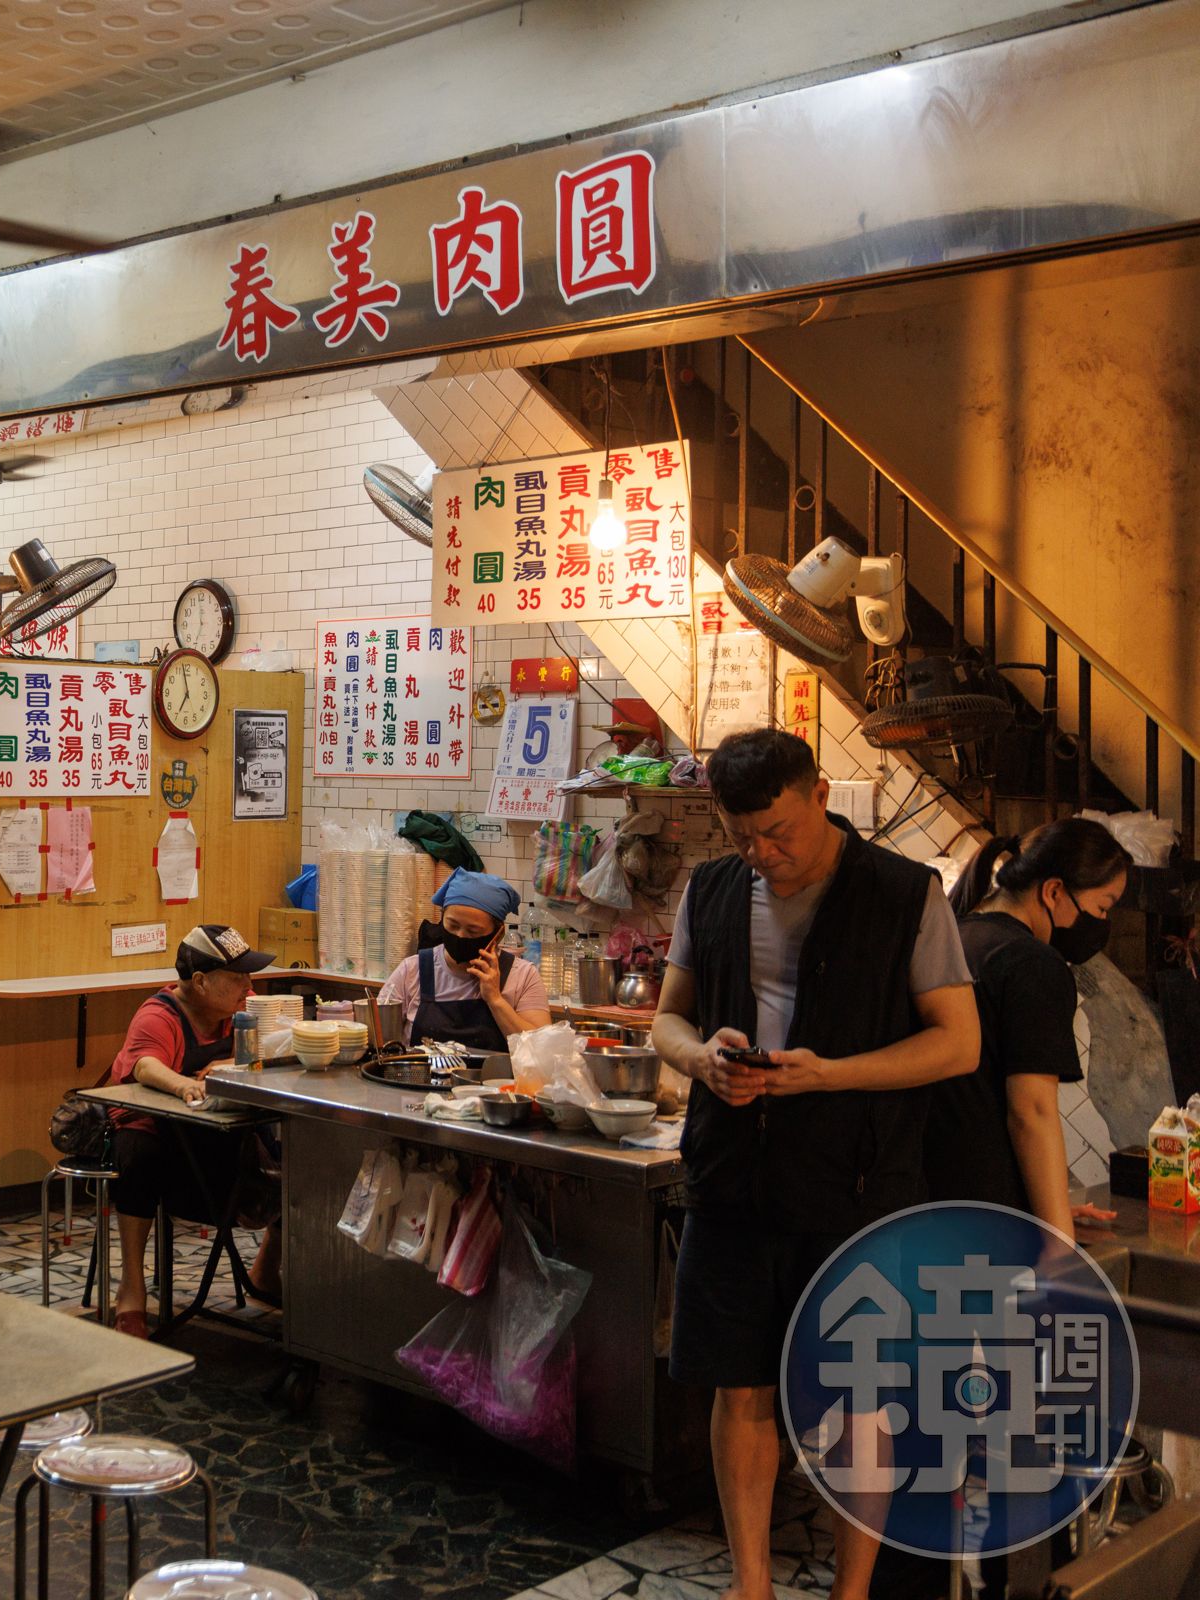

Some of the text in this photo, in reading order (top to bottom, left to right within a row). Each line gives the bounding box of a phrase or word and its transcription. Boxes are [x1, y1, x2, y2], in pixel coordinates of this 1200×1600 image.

[216, 149, 656, 364] 春美肉圓
[601, 448, 681, 485] 零售
[443, 494, 462, 607] 請先付款
[473, 476, 505, 613] 肉圓 40
[513, 470, 548, 610] 虱目魚丸湯 35
[556, 464, 591, 609] 貢丸湯 35
[617, 486, 665, 608] 虱目魚丸
[667, 501, 687, 605] 大包130元
[93, 671, 147, 695] 零售
[346, 631, 359, 672] 肉圓
[364, 647, 378, 749] 請先付款
[381, 629, 400, 766] 虱目魚丸湯 35
[404, 628, 421, 766] 貢丸湯 35
[426, 628, 443, 768] 肉圓 40
[448, 629, 467, 767] 歡迎外帶
[25, 673, 52, 788] 虱目魚丸湯 35
[58, 674, 84, 763] 貢丸湯
[91, 712, 103, 790] 小包65元
[104, 698, 136, 790] 虱目魚丸
[135, 713, 149, 790] 大包130元
[523, 706, 552, 765] 5
[708, 698, 740, 710] 使用袋
[62, 769, 81, 788] 35
[322, 751, 334, 765] 65
[517, 768, 546, 777] 星期二
